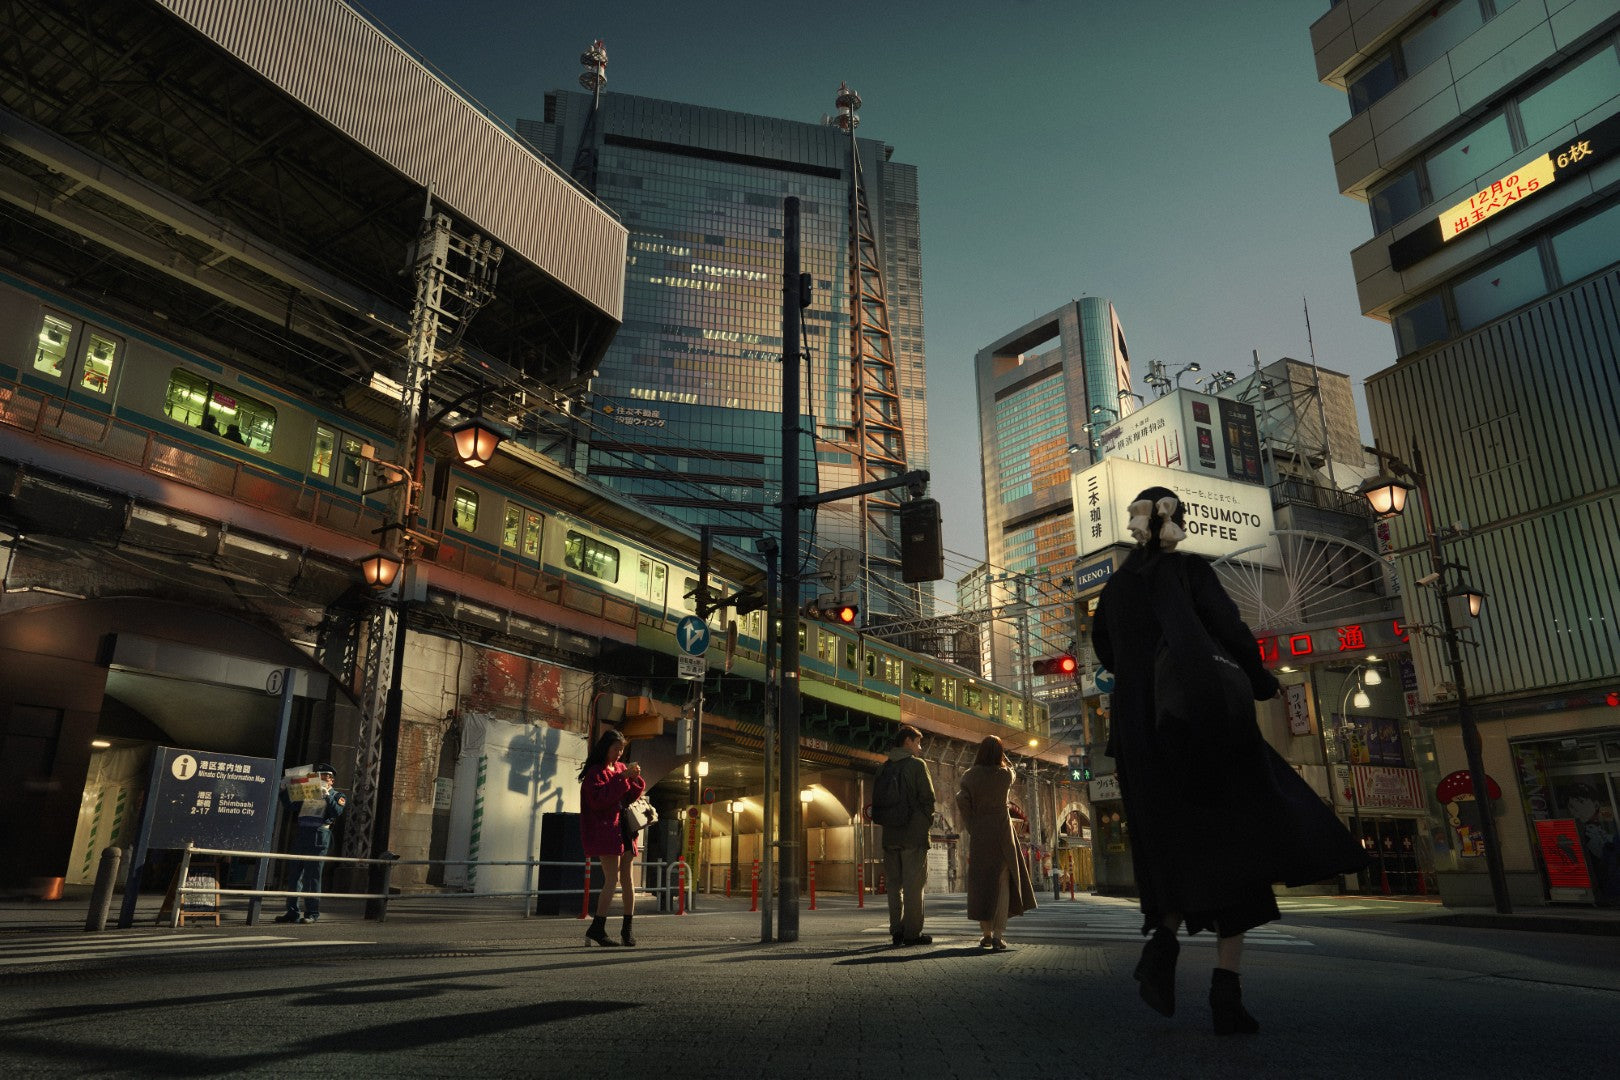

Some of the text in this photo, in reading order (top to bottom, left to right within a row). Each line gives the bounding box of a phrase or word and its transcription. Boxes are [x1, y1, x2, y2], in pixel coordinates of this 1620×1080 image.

[1557, 139, 1593, 169] 6枚
[1469, 174, 1519, 209] 12月の
[1454, 178, 1539, 233] 出玉ベスト5
[1087, 475, 1103, 539] 三本珈琲
[1185, 501, 1261, 528] ITSUMOTO
[199, 760, 251, 774] 港区案内地図
[197, 770, 266, 784] Minato City Information Map
[197, 791, 212, 800] 港区
[196, 799, 212, 808] 新橋
[218, 799, 254, 808] Shimbashi
[190, 807, 210, 815] 2-17
[241, 808, 255, 817] City
